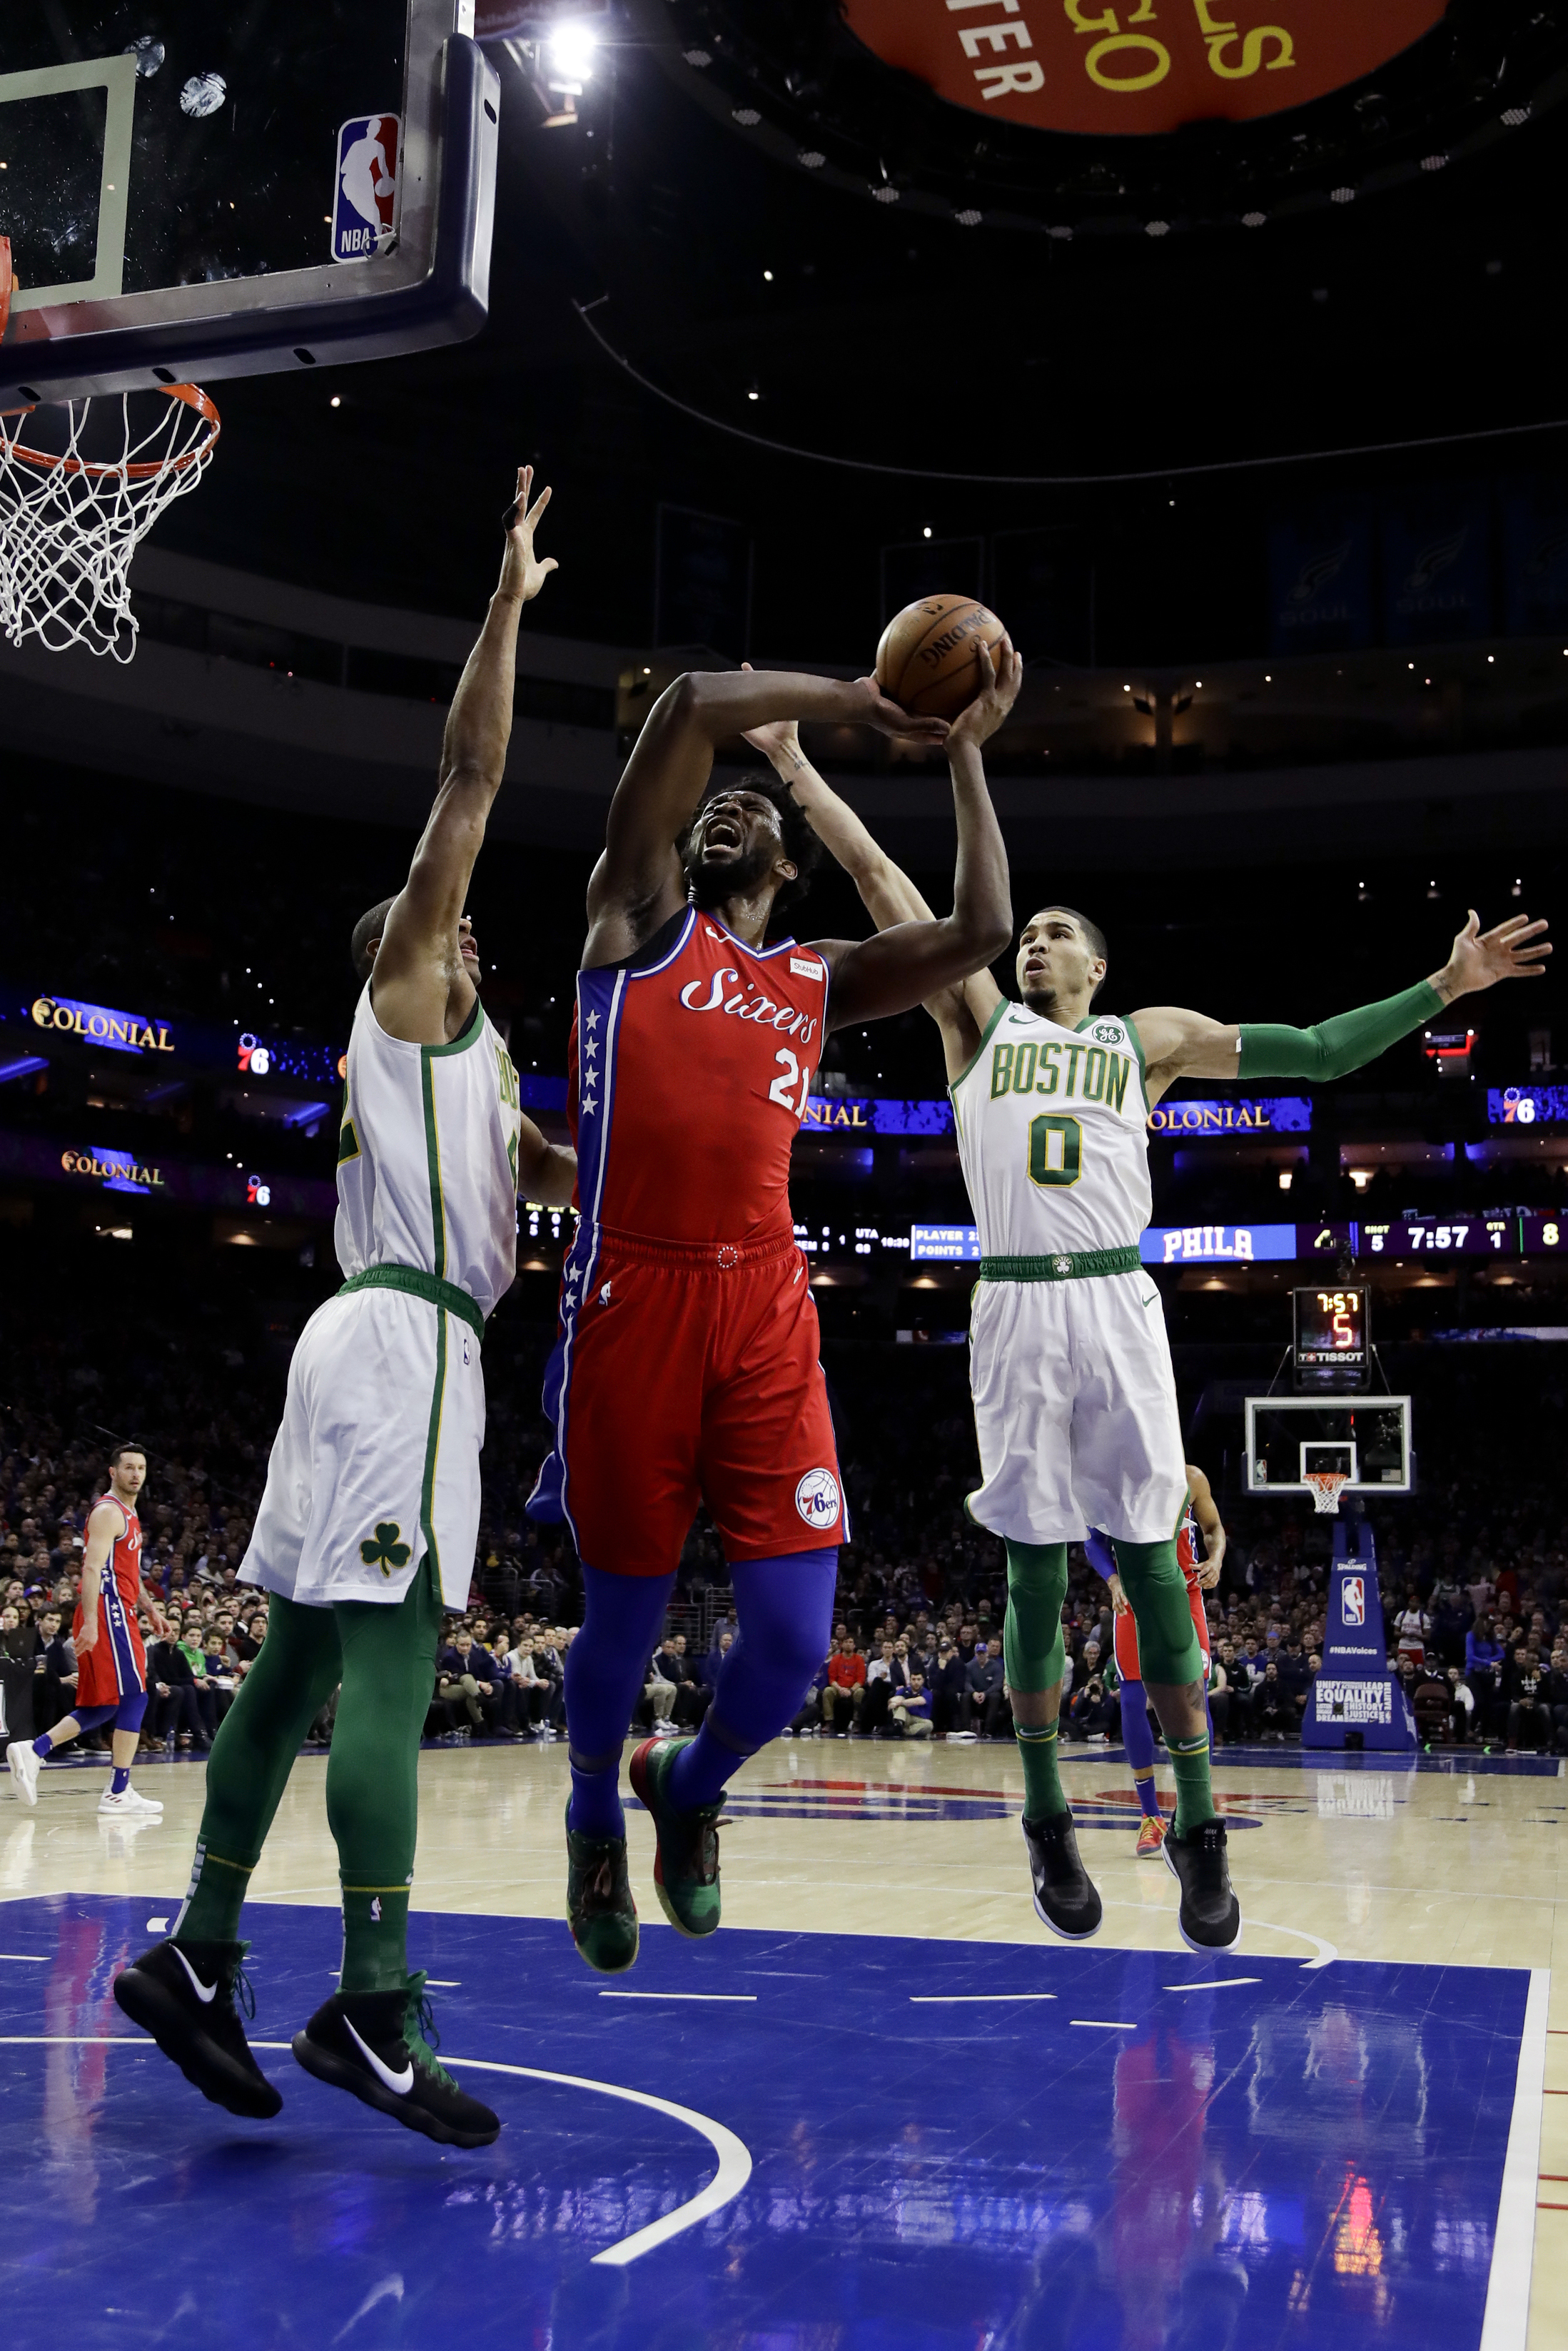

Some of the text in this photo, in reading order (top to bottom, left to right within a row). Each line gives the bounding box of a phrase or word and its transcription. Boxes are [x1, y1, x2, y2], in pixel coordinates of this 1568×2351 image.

[340, 228, 370, 253] NBA
[794, 962, 819, 976] StubHub
[679, 967, 818, 1044] Sixers
[31, 997, 175, 1052] COLONIAL
[237, 1045, 270, 1074] 76
[768, 1047, 809, 1118] 21
[990, 1042, 1131, 1116] BOSTON
[1503, 1098, 1535, 1123] 76
[1027, 1113, 1083, 1189] 0
[61, 1150, 165, 1186] COLONIAL
[247, 1183, 270, 1205] 76
[839, 1235, 846, 1245] 1
[856, 1228, 879, 1240] UTA
[916, 1229, 963, 1240] PLAYER
[1365, 1225, 1390, 1234] SHOT
[1408, 1225, 1469, 1249] 7:57
[1490, 1232, 1501, 1248] 1
[1542, 1223, 1559, 1245] 8
[855, 1243, 871, 1254] GS
[918, 1245, 963, 1255] POINTS
[1163, 1226, 1254, 1263] PHILA
[1371, 1235, 1384, 1252] 5
[1053, 1256, 1072, 1265] CELTICS
[1317, 1293, 1358, 1314] 7:57
[1332, 1313, 1352, 1347] 5
[1316, 1353, 1364, 1362] TISSOT
[802, 1492, 837, 1516] 76ers
[1329, 1646, 1377, 1655] #NBAVoices
[1316, 1680, 1341, 1689] UNIFY
[1316, 1689, 1383, 1703] EQUALITY
[1350, 1702, 1383, 1711] HISTORY
